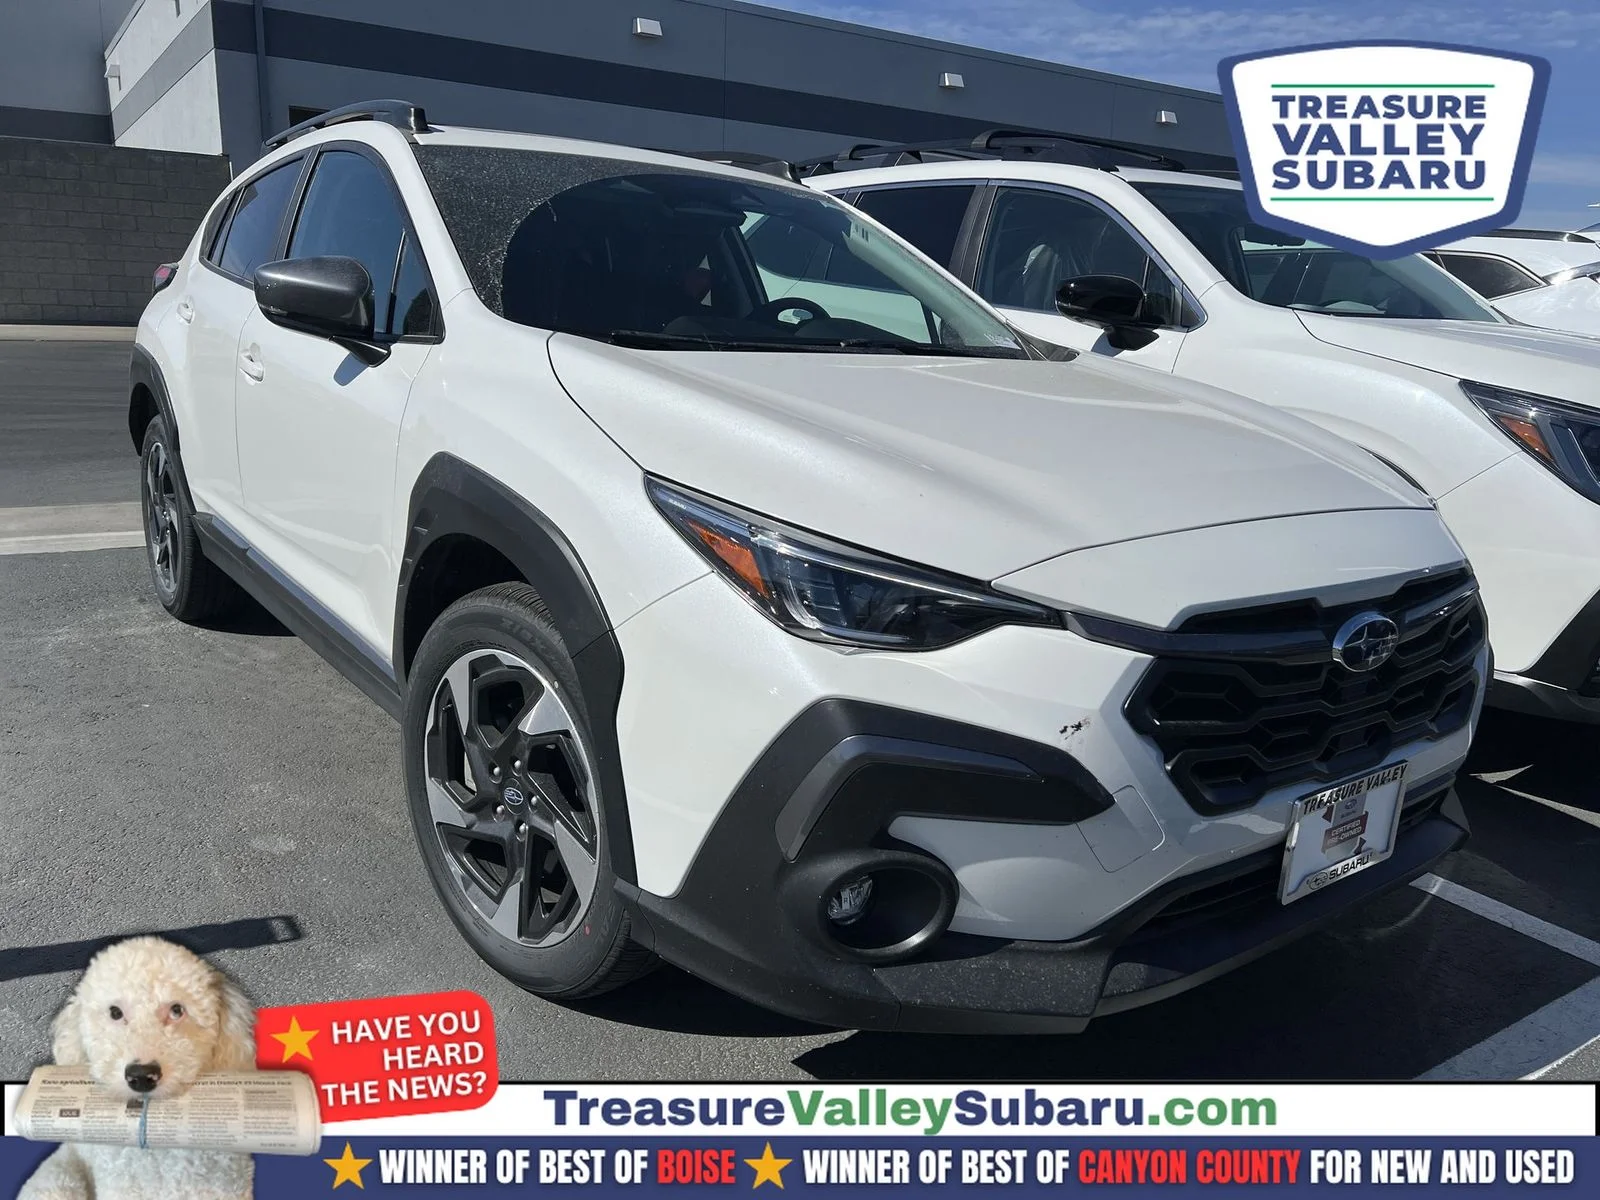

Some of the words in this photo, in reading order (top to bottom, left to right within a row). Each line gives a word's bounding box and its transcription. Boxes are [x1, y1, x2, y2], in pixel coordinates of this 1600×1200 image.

[1304, 782, 1364, 815] TREASURE
[1366, 765, 1407, 791] VALLEY
[1329, 856, 1370, 880] SUBARU
